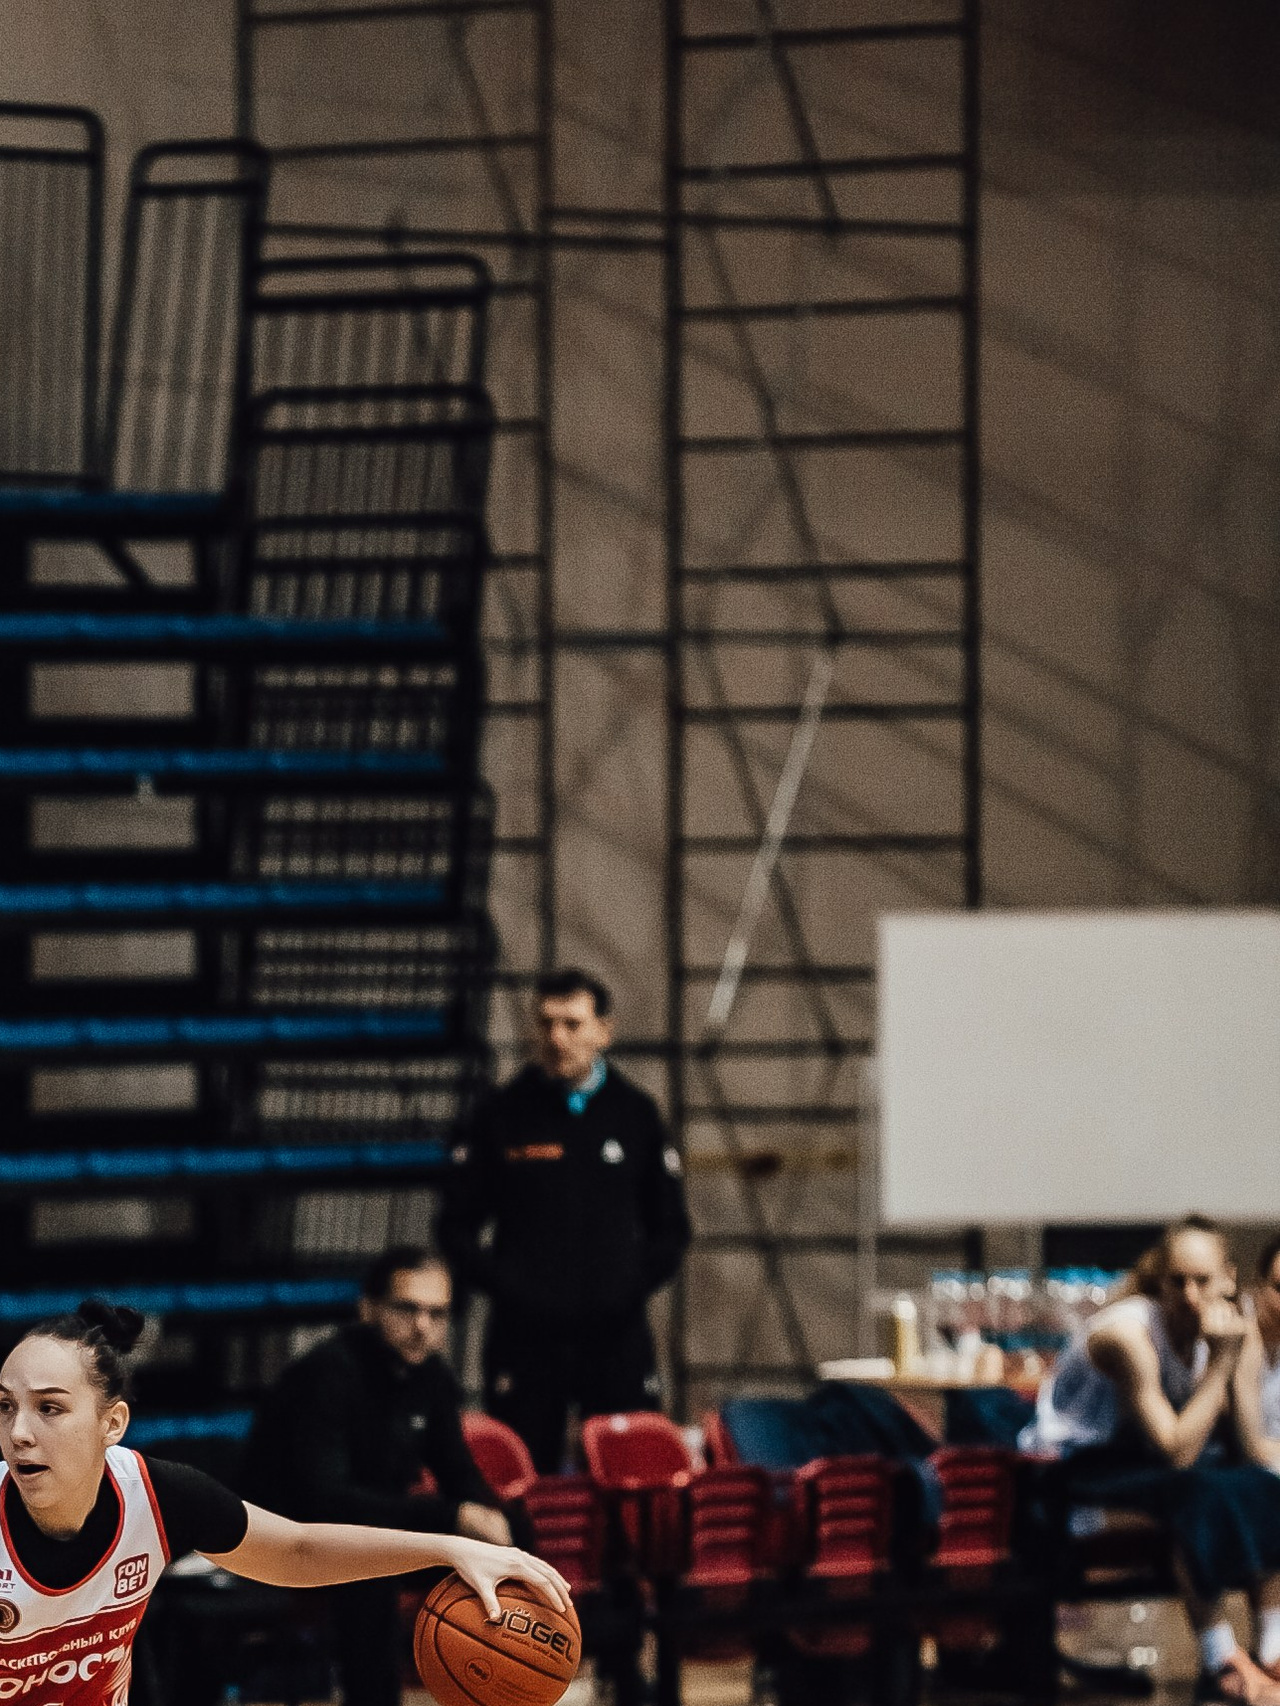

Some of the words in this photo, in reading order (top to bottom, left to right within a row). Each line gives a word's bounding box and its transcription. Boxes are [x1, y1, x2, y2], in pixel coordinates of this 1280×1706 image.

[116, 1556, 147, 1580] FON
[116, 1573, 147, 1595] BET
[108, 1618, 138, 1641] КЛУБ
